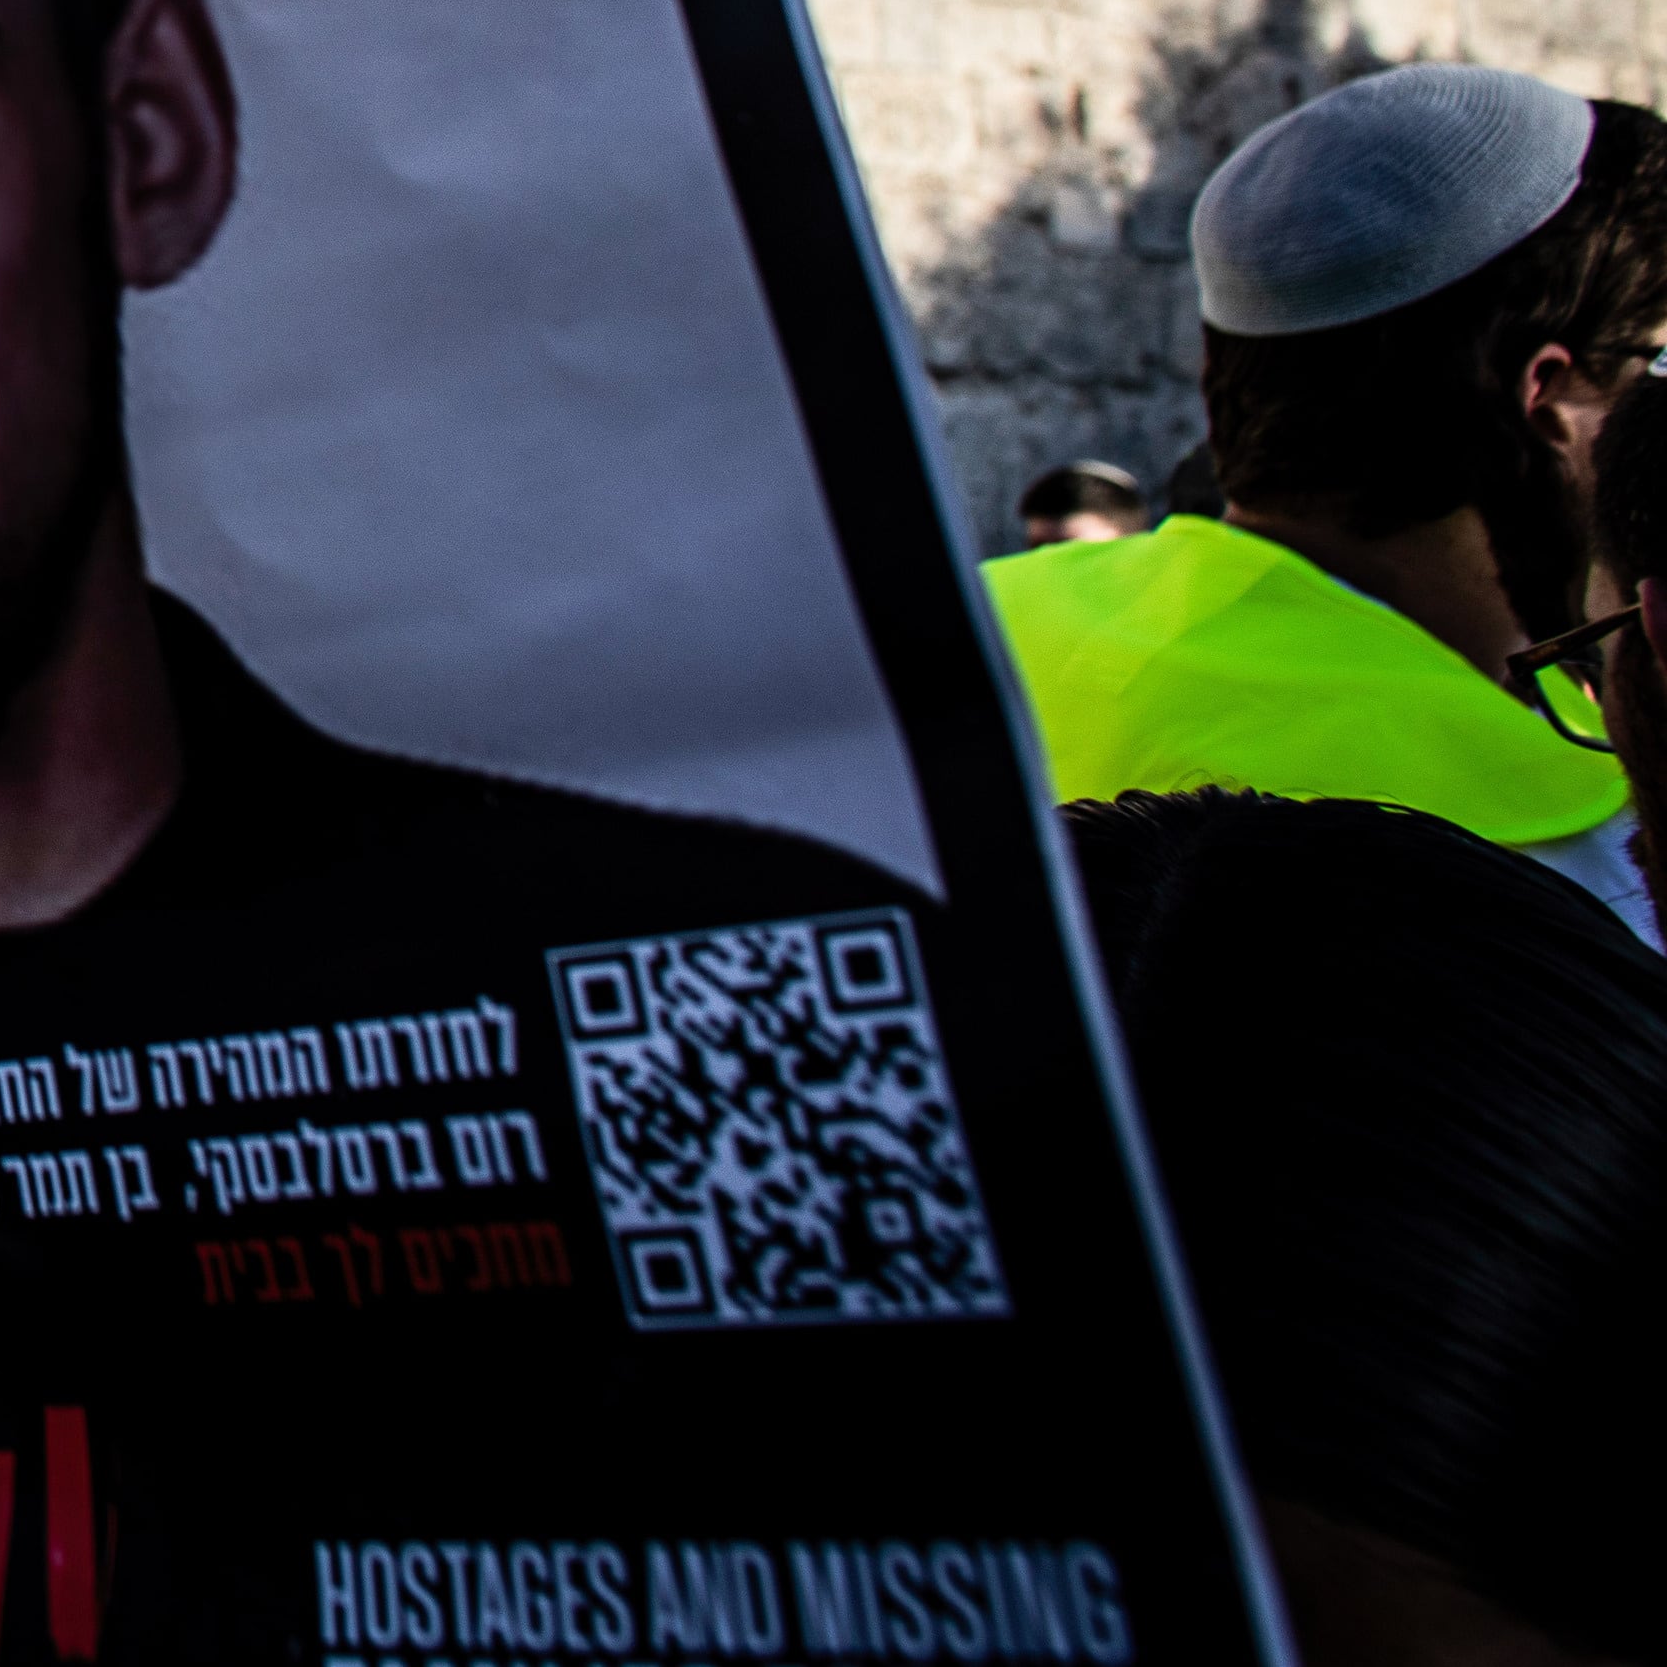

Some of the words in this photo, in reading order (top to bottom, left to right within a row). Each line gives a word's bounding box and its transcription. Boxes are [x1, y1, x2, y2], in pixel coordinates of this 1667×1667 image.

[63, 1042, 140, 1117] של
[147, 1027, 331, 1109] המהירה
[335, 994, 518, 1090] לחזרתו
[1, 1148, 100, 1221] תמר
[102, 1144, 160, 1222] בן
[445, 1109, 549, 1185] רום
[195, 1236, 315, 1306] בבית
[322, 1223, 385, 1309] לך
[398, 1220, 574, 1296] מחכים
[313, 1539, 635, 1654] HOSTAGES
[647, 1540, 784, 1656] AND
[789, 1540, 1135, 1662] MISSING
